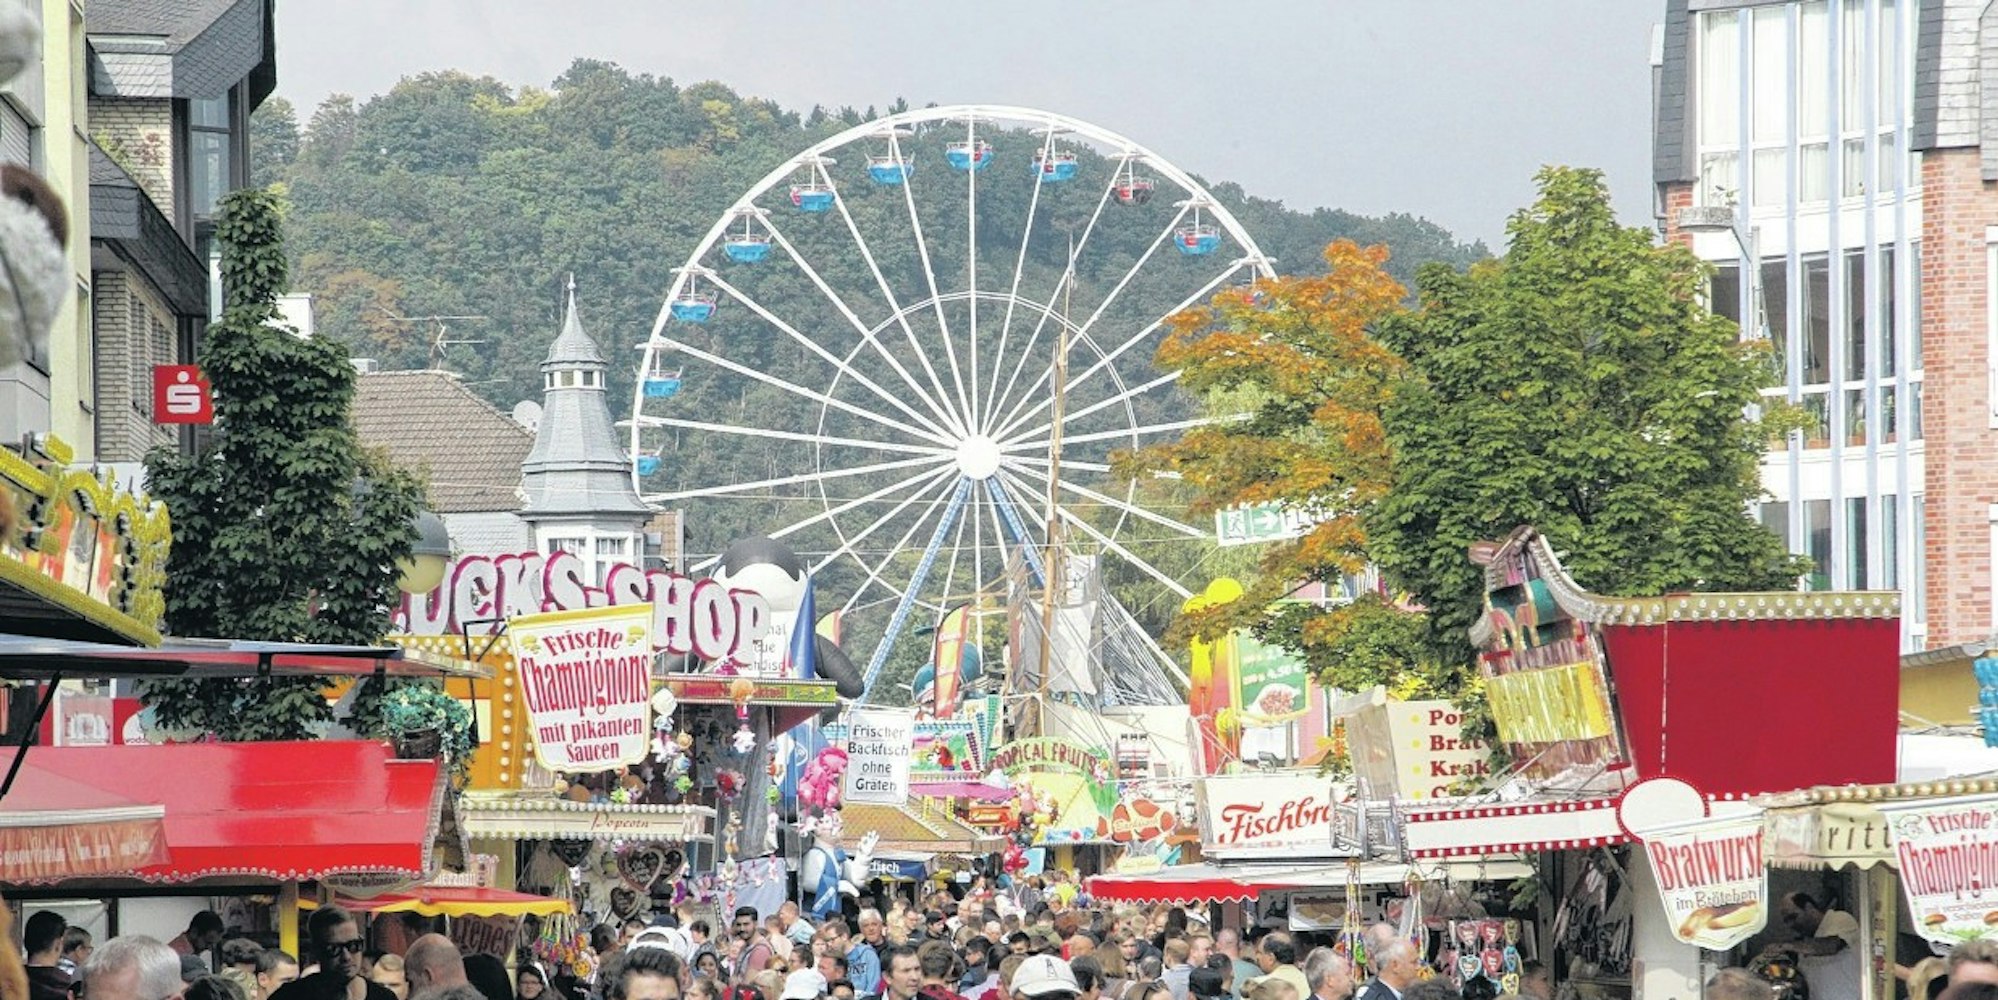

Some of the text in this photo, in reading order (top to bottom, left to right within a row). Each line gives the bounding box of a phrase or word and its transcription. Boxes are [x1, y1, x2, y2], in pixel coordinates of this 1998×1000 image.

[391, 551, 771, 667] UCKS-SHOP
[542, 628, 623, 656] Frische
[521, 651, 649, 717] Champignons
[540, 718, 642, 744] mit pikanten
[853, 725, 905, 738] Frischer
[566, 742, 620, 763] Saucen
[848, 742, 909, 756] Backfisch
[1430, 735, 1483, 751] Brat
[862, 762, 892, 773] ohne
[1430, 760, 1490, 777] Krak
[590, 811, 649, 831] Popcorn
[1927, 808, 1992, 835] Frische
[1650, 825, 1764, 890] Bratwurst
[1900, 834, 1998, 900] Champigno
[1676, 889, 1757, 911] im Brötchen
